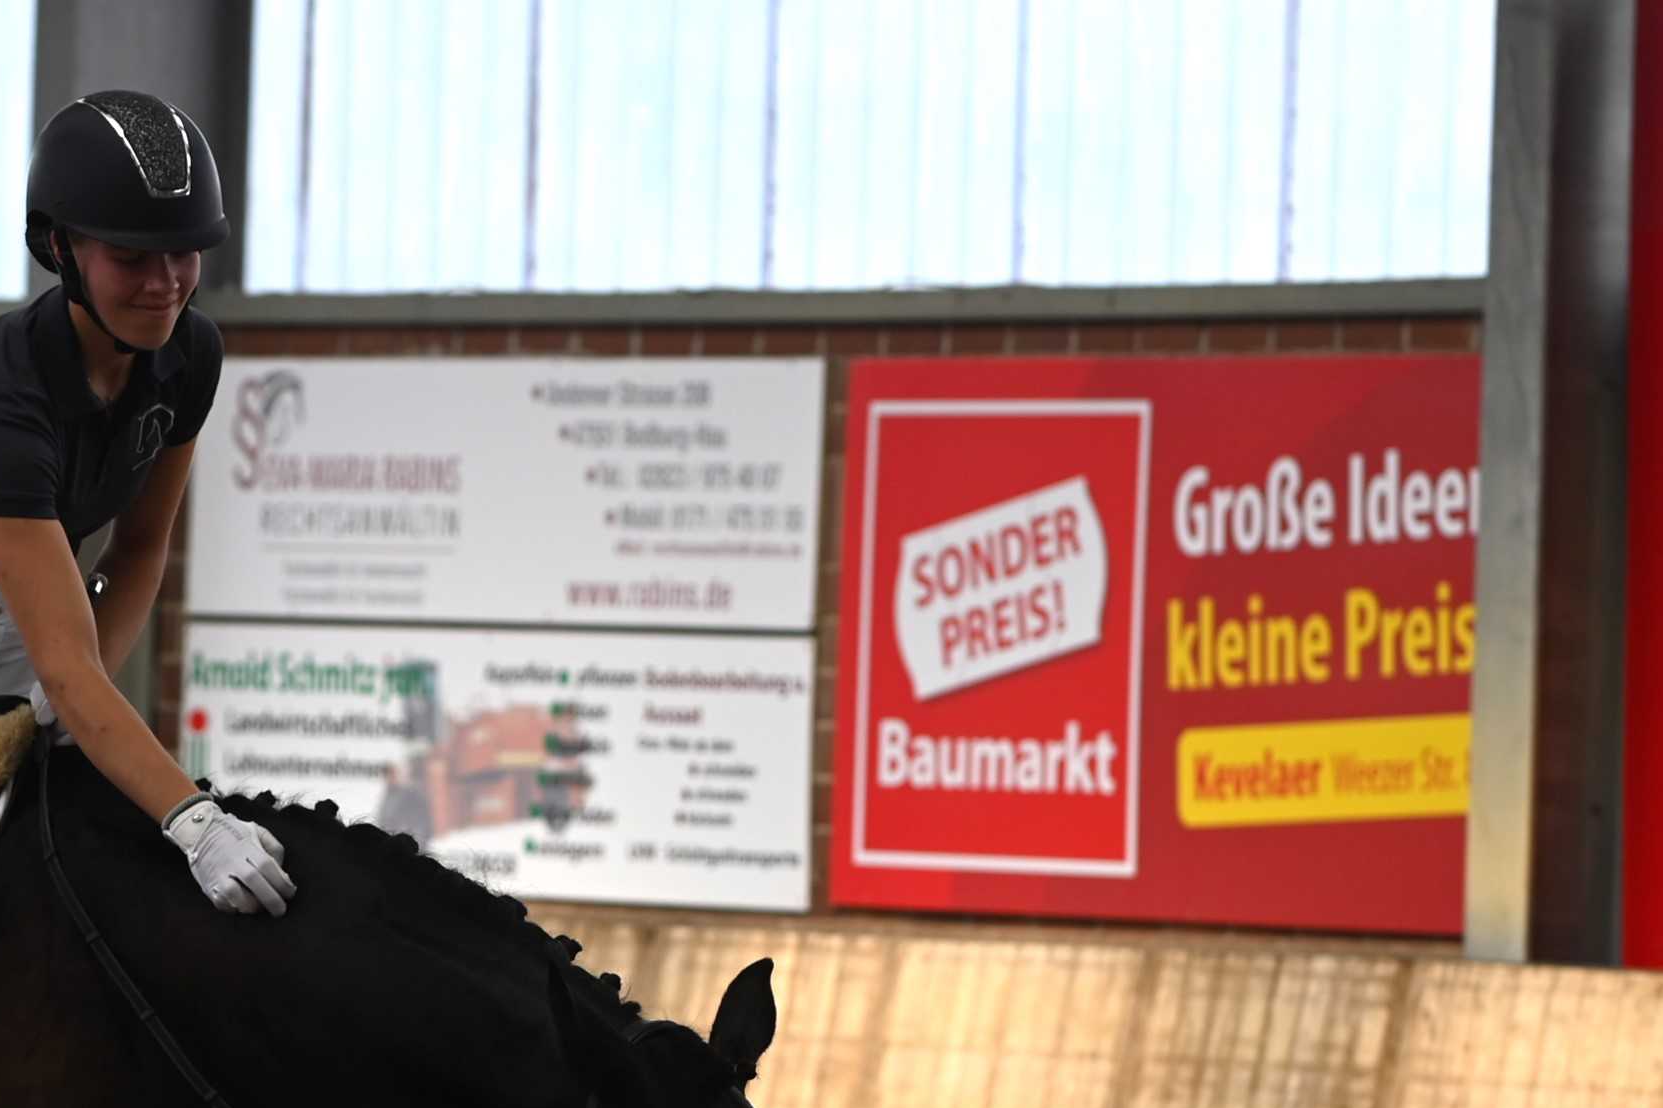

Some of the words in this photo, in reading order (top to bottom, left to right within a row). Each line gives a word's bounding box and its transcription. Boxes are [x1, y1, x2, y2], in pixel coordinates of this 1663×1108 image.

[1172, 455, 1335, 559] Große
[911, 504, 1084, 610] SONDER
[937, 579, 1068, 668] PREIS!
[1166, 593, 1331, 692] kleine
[192, 648, 271, 690] Arnold
[277, 649, 376, 696] Schmitz
[877, 717, 1118, 796] Baumarkt
[1192, 746, 1324, 801] Kevelaer
